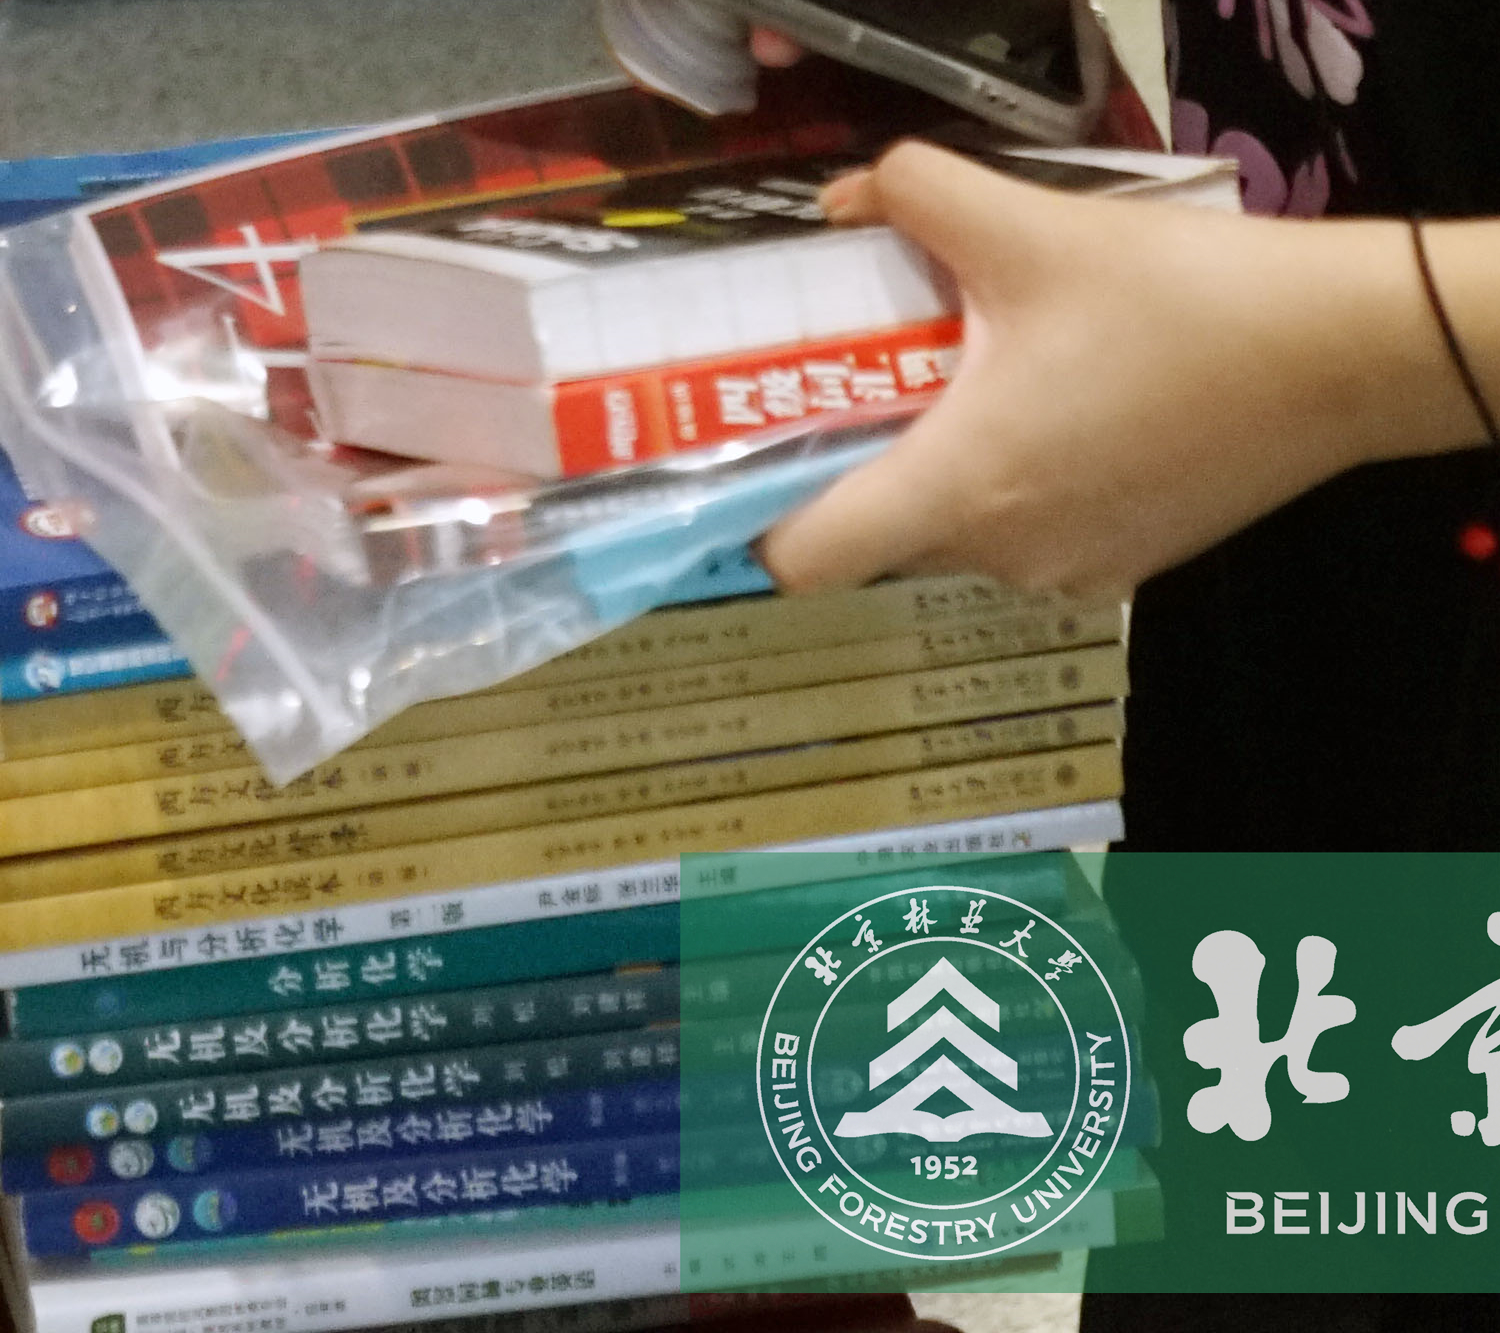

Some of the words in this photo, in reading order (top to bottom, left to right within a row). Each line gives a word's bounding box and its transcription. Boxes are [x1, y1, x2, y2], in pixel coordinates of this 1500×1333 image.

[81, 919, 346, 972] 无机与分析化学
[267, 945, 445, 998] 分析化学
[145, 1002, 450, 1065] 无机及分析化学
[179, 1059, 482, 1125] 无机及分析化学
[276, 1098, 554, 1159] 无机及分析化学
[301, 1155, 580, 1218] 无机及分析化学
